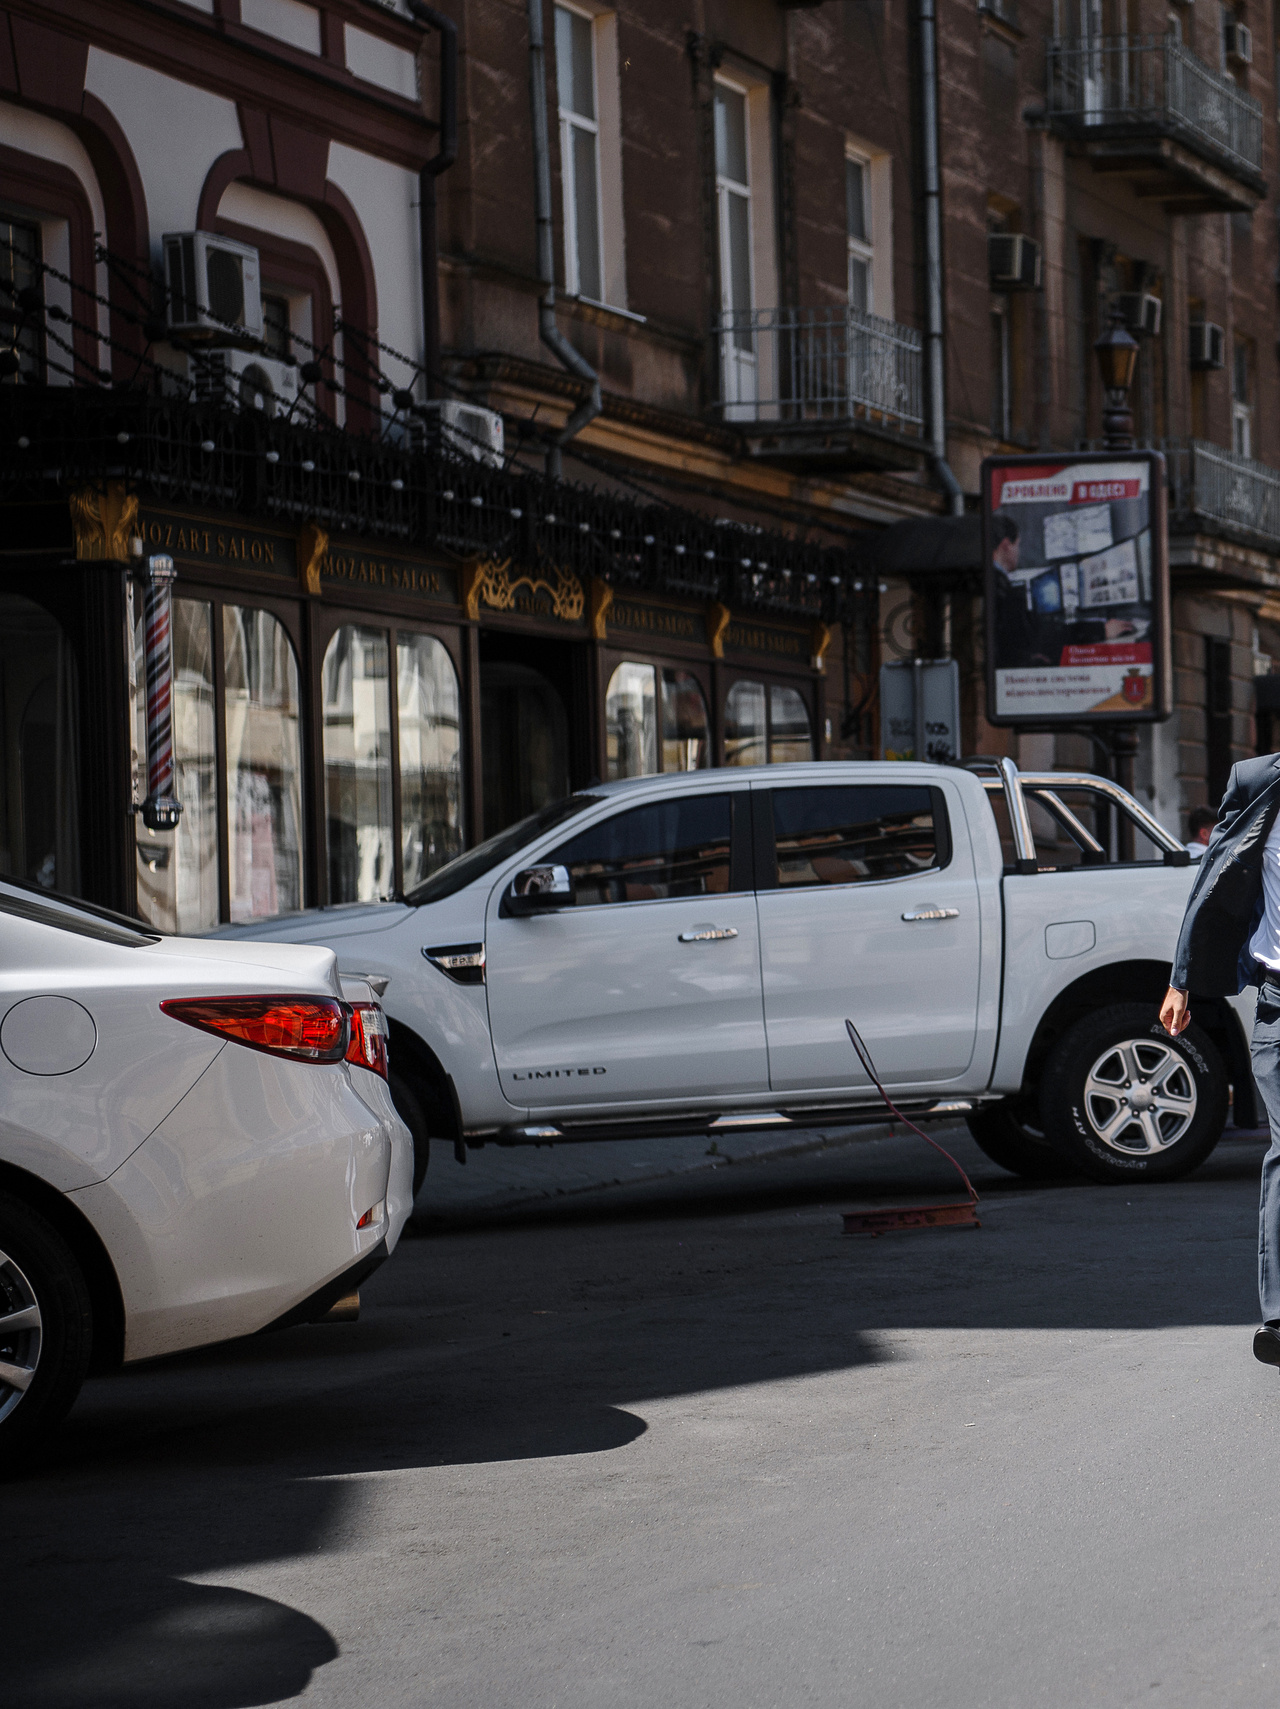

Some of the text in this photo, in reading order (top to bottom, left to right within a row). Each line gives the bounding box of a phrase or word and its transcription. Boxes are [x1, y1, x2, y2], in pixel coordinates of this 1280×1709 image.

[133, 520, 275, 564] MOZART SALON
[323, 554, 441, 593] MOZART SALON
[513, 1066, 607, 1081] LIMITED
